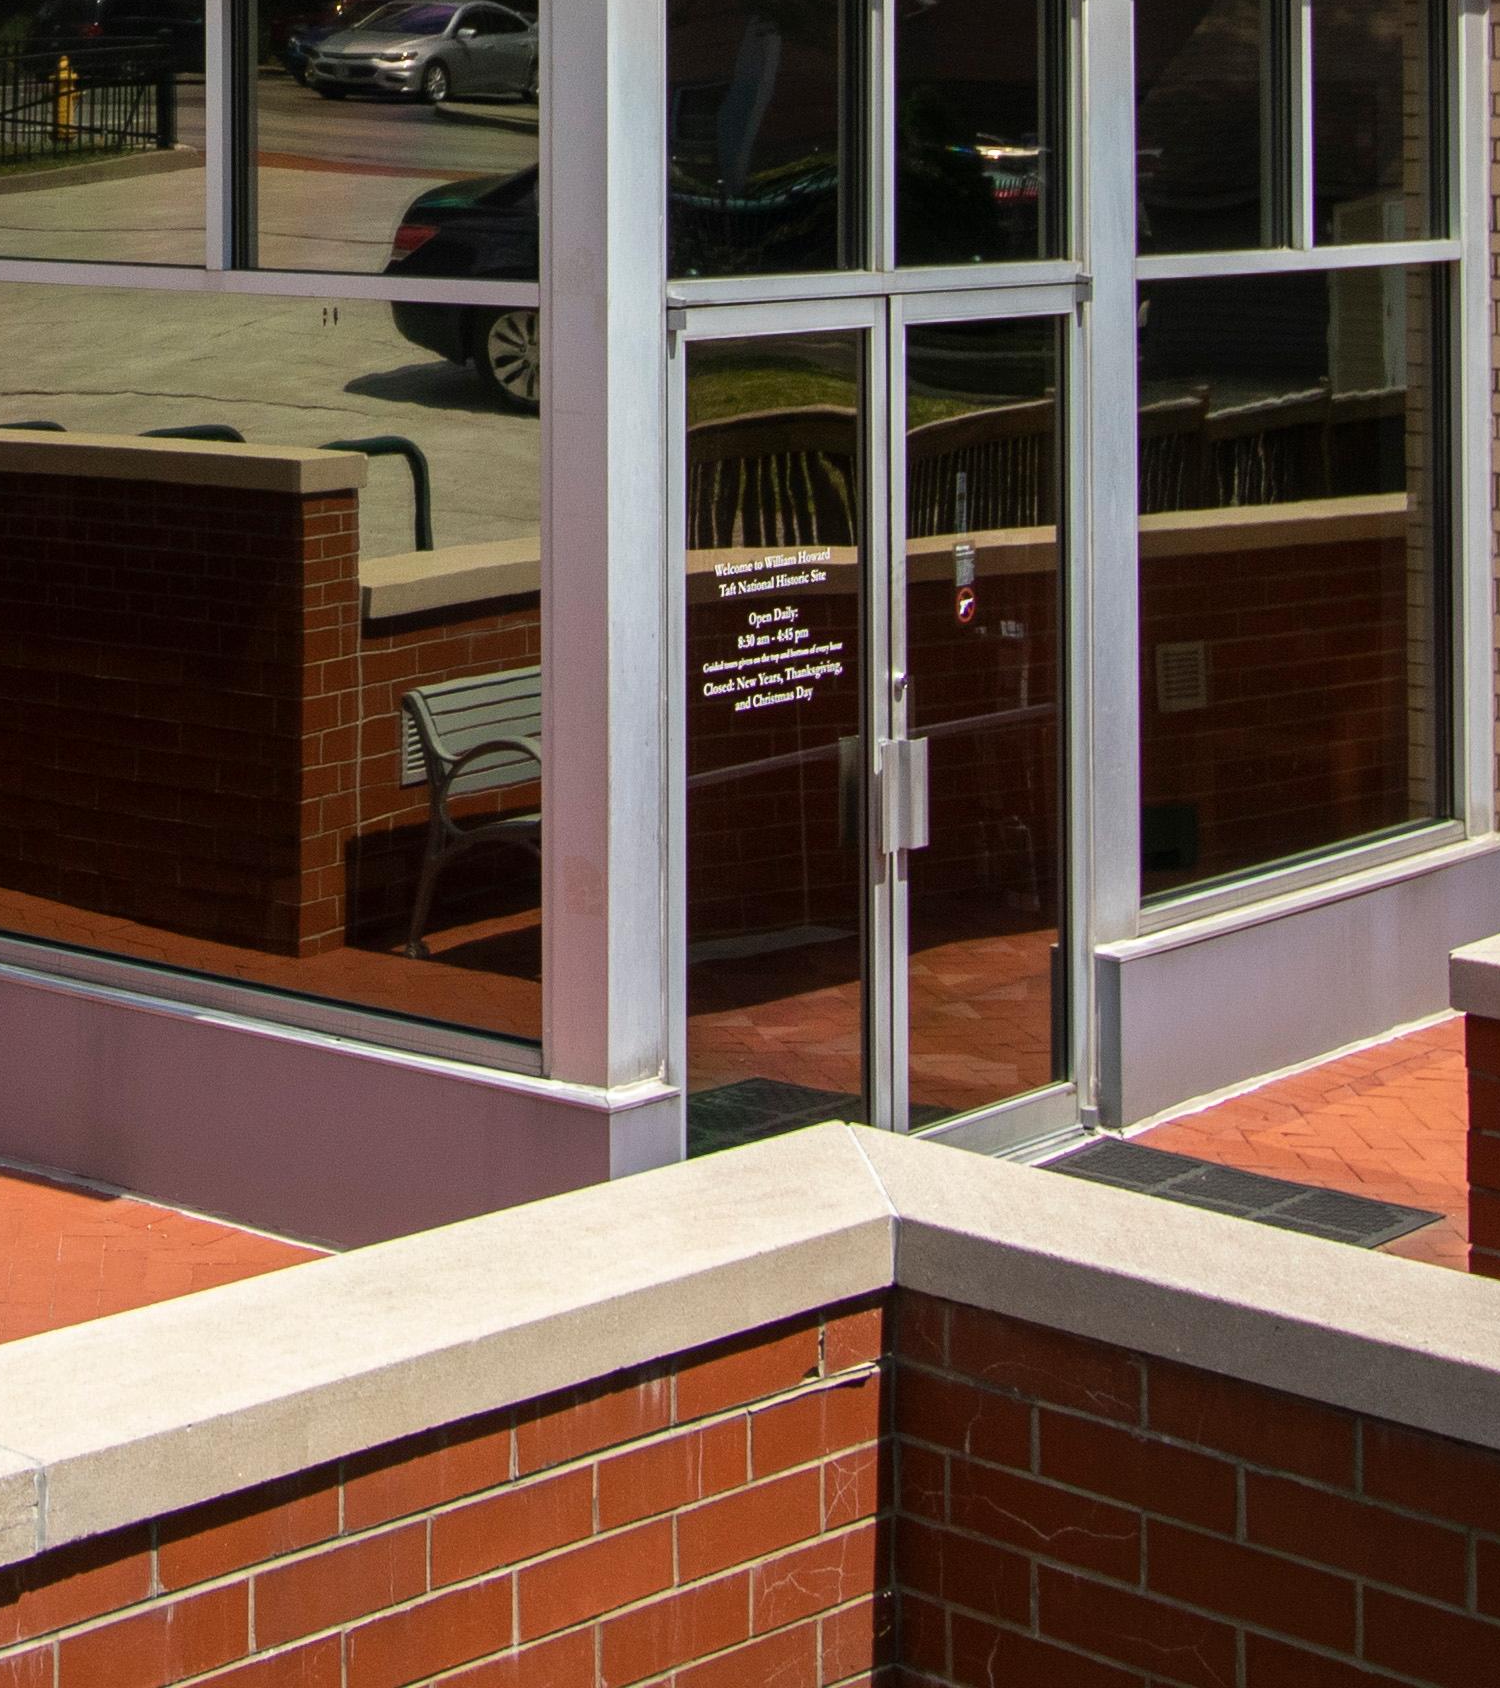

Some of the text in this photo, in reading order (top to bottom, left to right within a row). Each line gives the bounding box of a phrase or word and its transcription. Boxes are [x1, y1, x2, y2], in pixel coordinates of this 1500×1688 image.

[714, 547, 831, 577] Welcome to William Howard
[719, 569, 827, 597] Taft National Historic Site
[748, 606, 799, 629] Open Daily:
[738, 634, 756, 649] 8:30
[756, 635, 771, 646] am
[776, 627, 794, 643] 4:45
[795, 628, 809, 643] pm
[703, 660, 843, 696] Closed: New Years, Thanksgiving,
[734, 685, 814, 711] and Christmas Day
